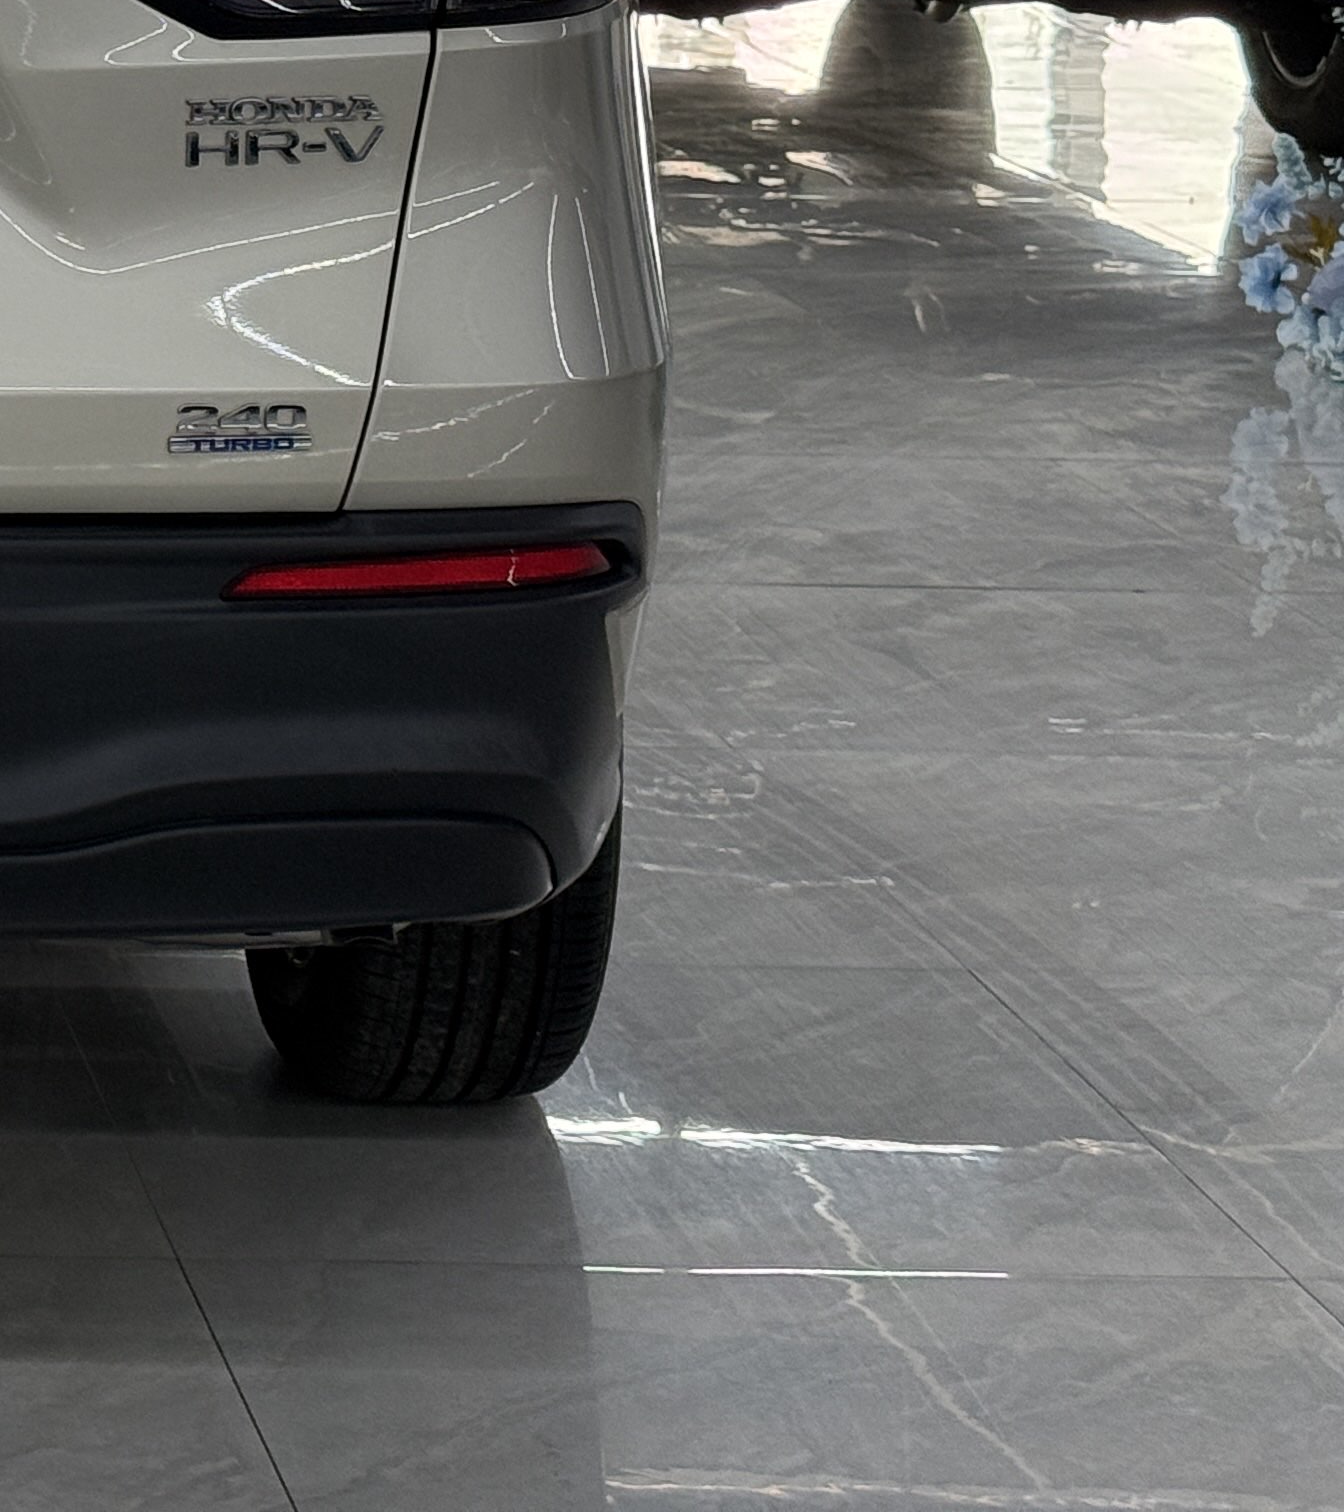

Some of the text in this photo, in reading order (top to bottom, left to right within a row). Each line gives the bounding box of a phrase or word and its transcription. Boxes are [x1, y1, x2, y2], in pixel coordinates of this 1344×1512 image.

[185, 96, 384, 126] HONDA
[185, 125, 384, 167] HR-V
[177, 403, 307, 435] 240
[186, 437, 296, 454] TURBO
